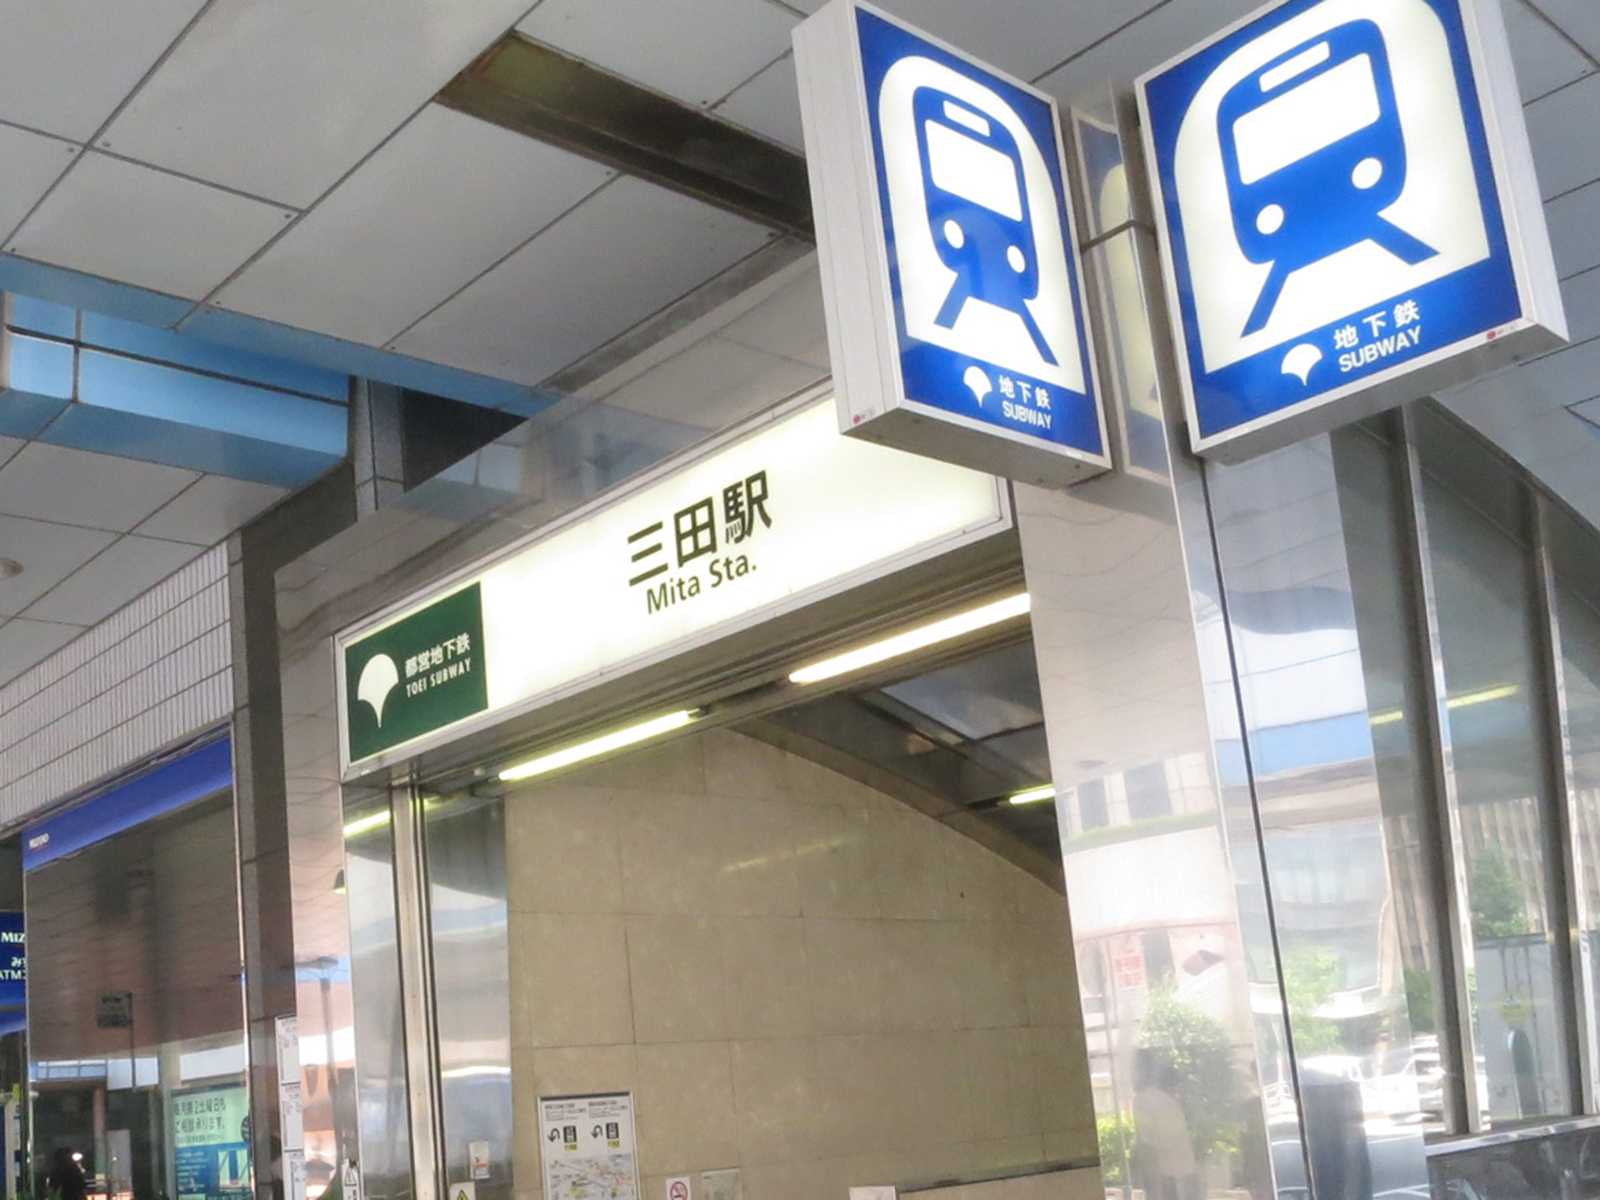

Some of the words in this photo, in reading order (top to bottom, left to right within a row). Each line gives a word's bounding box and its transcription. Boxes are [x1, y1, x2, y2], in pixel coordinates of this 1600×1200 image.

[1333, 299, 1420, 350] 地下鉄
[1338, 325, 1421, 373] SUBWAY
[999, 374, 1051, 411] 地下鉄
[1002, 400, 1052, 430] SUBWAY
[627, 469, 772, 587] 三田駅
[646, 575, 701, 615] Mita
[709, 554, 757, 588] Sta.
[405, 632, 470, 678] 都営地下鉄
[406, 677, 427, 698] TOEI
[430, 657, 471, 687] SUBWAY
